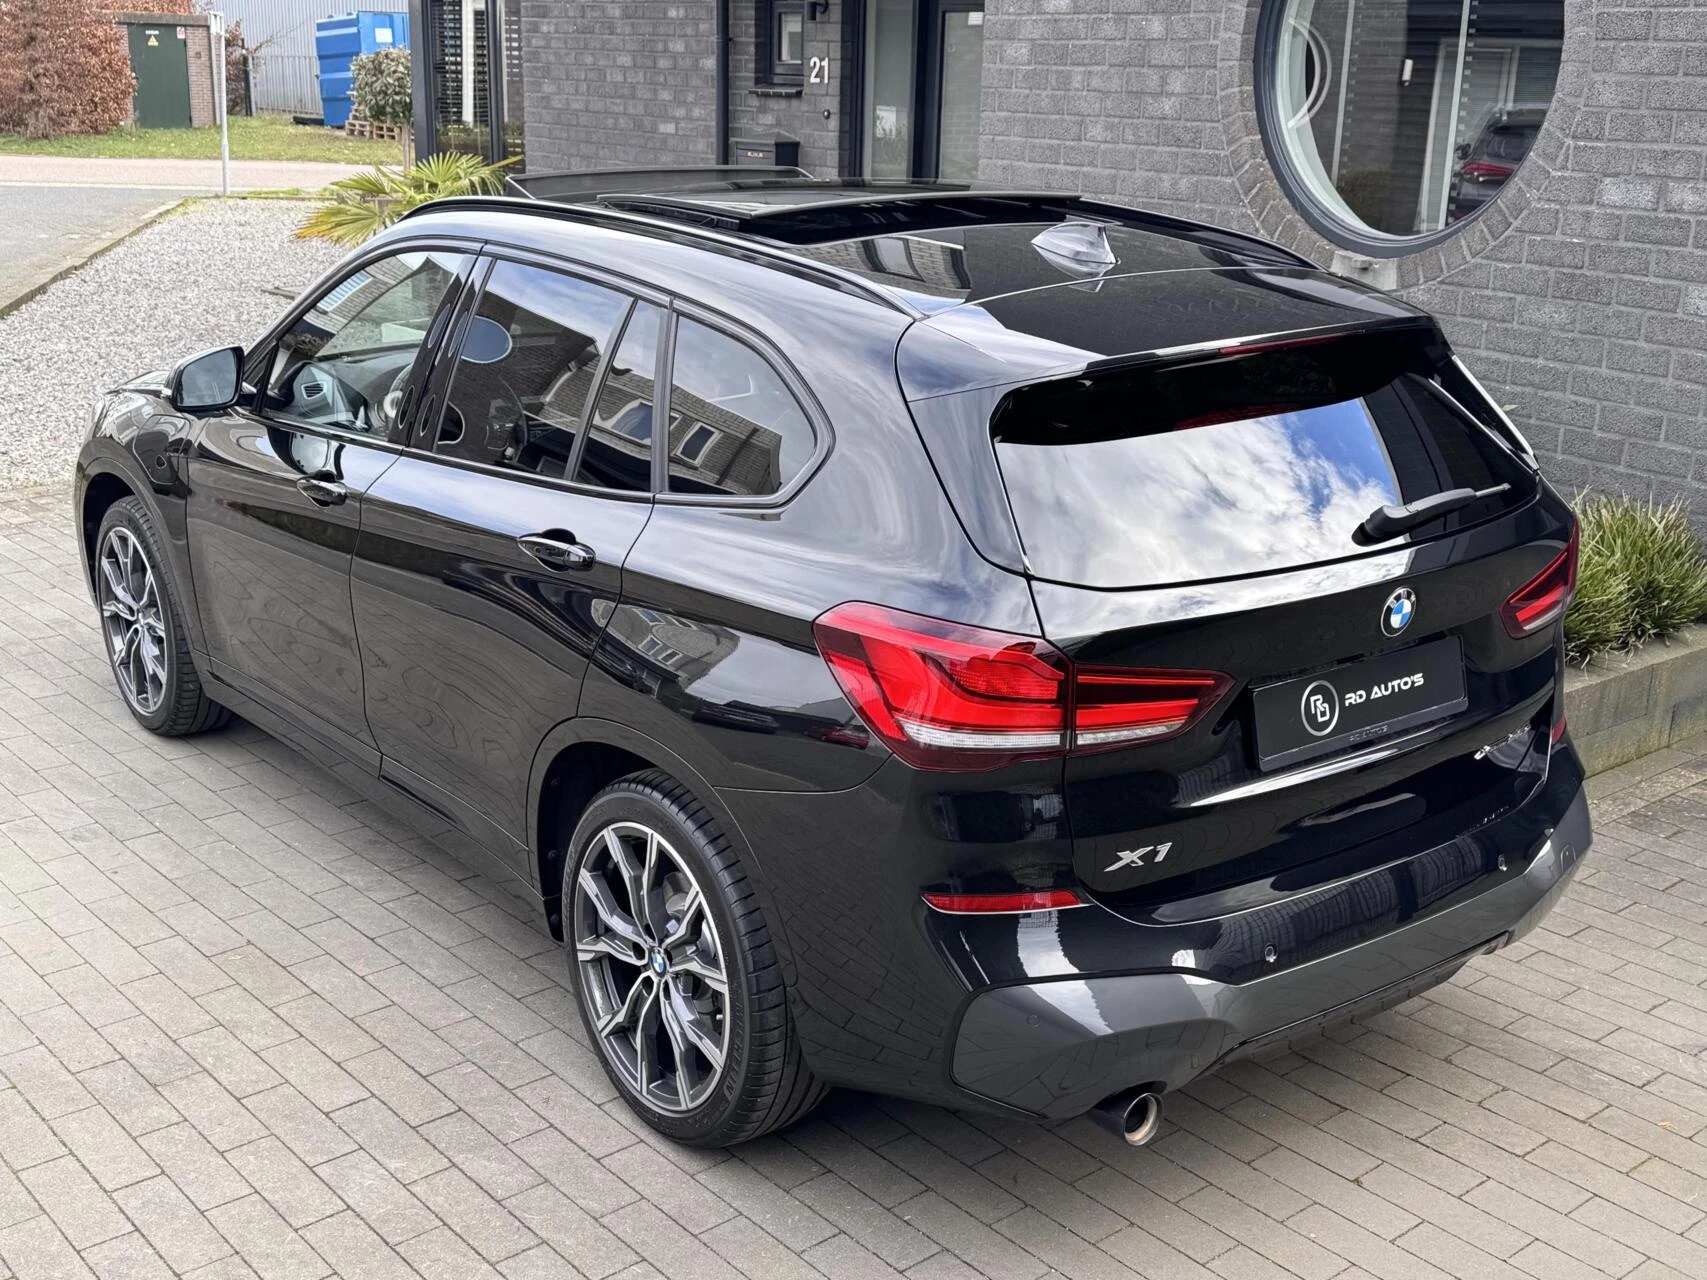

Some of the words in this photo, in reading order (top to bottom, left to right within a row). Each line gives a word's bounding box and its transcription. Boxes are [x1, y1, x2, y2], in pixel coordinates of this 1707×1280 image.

[810, 56, 829, 84] 21
[1344, 689, 1367, 707] RD
[1370, 672, 1424, 700] AUTO'S
[1103, 841, 1173, 873] X1
